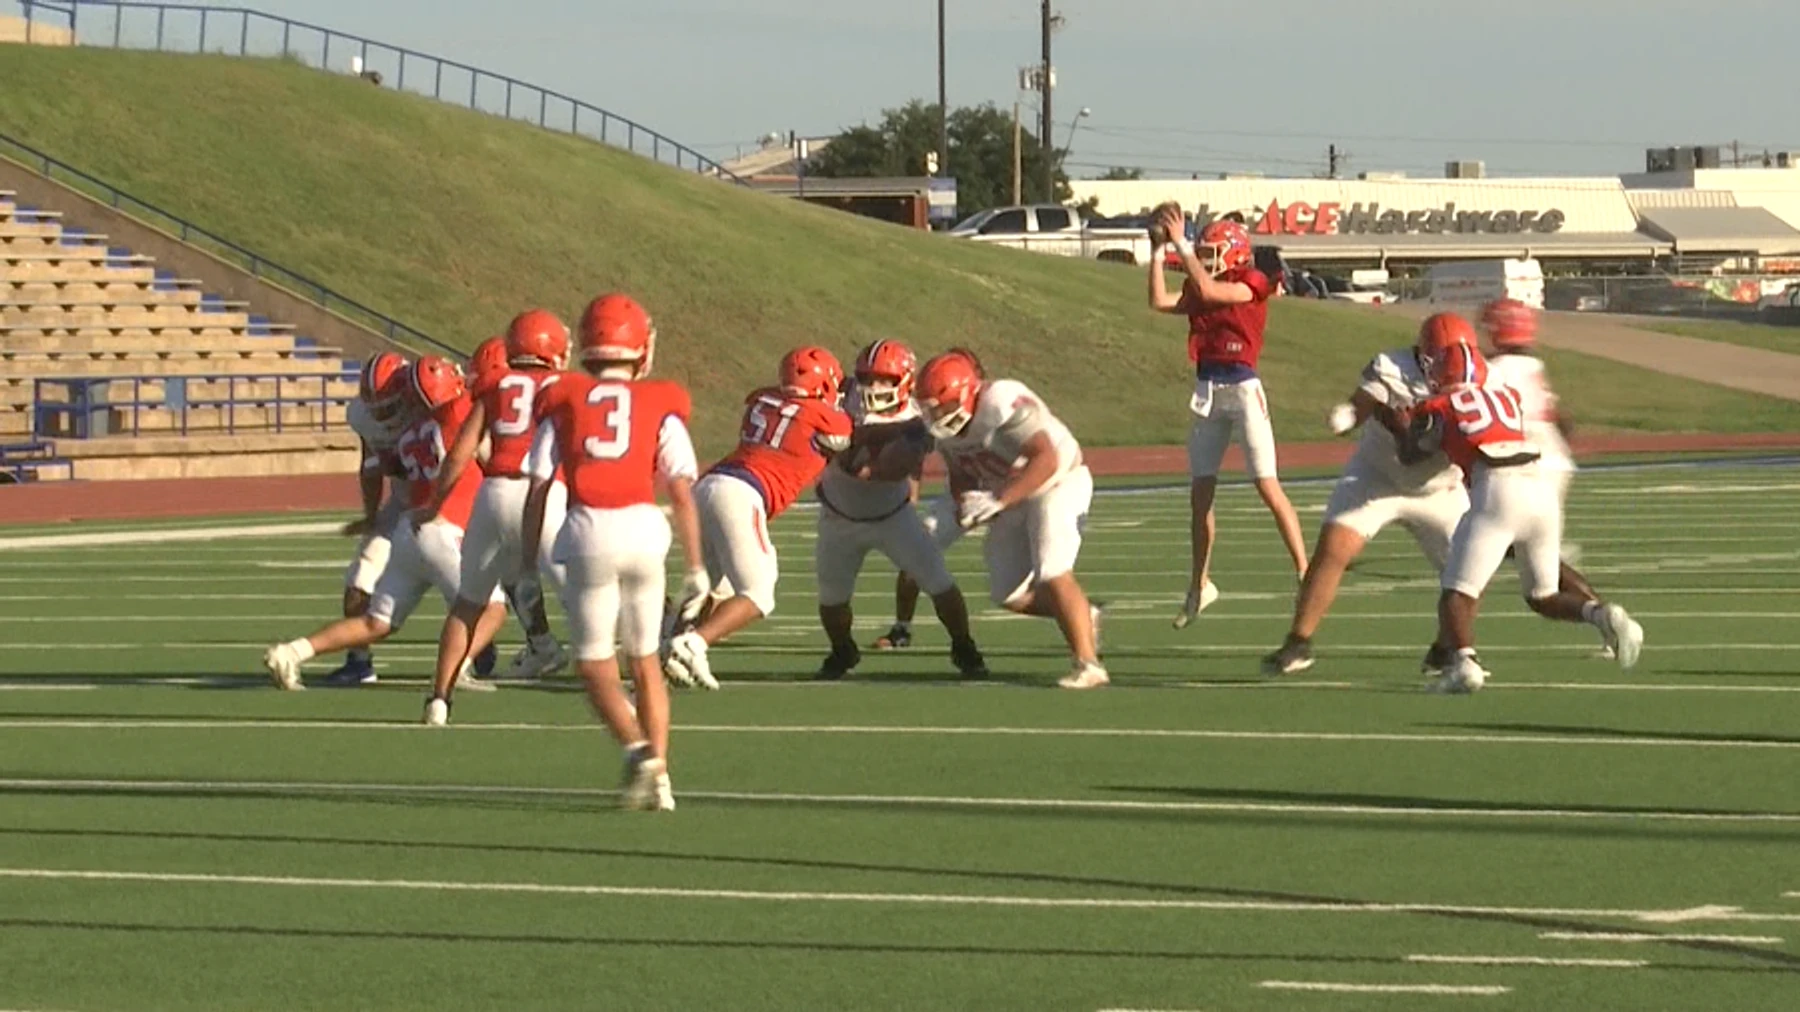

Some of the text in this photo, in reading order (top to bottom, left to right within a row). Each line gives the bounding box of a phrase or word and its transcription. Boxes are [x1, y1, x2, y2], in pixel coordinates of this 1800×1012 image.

[1255, 198, 1340, 235] ACE
[1339, 201, 1565, 234] Hardware
[584, 383, 632, 459] 3
[740, 394, 802, 450] 51
[1450, 386, 1524, 435] 90
